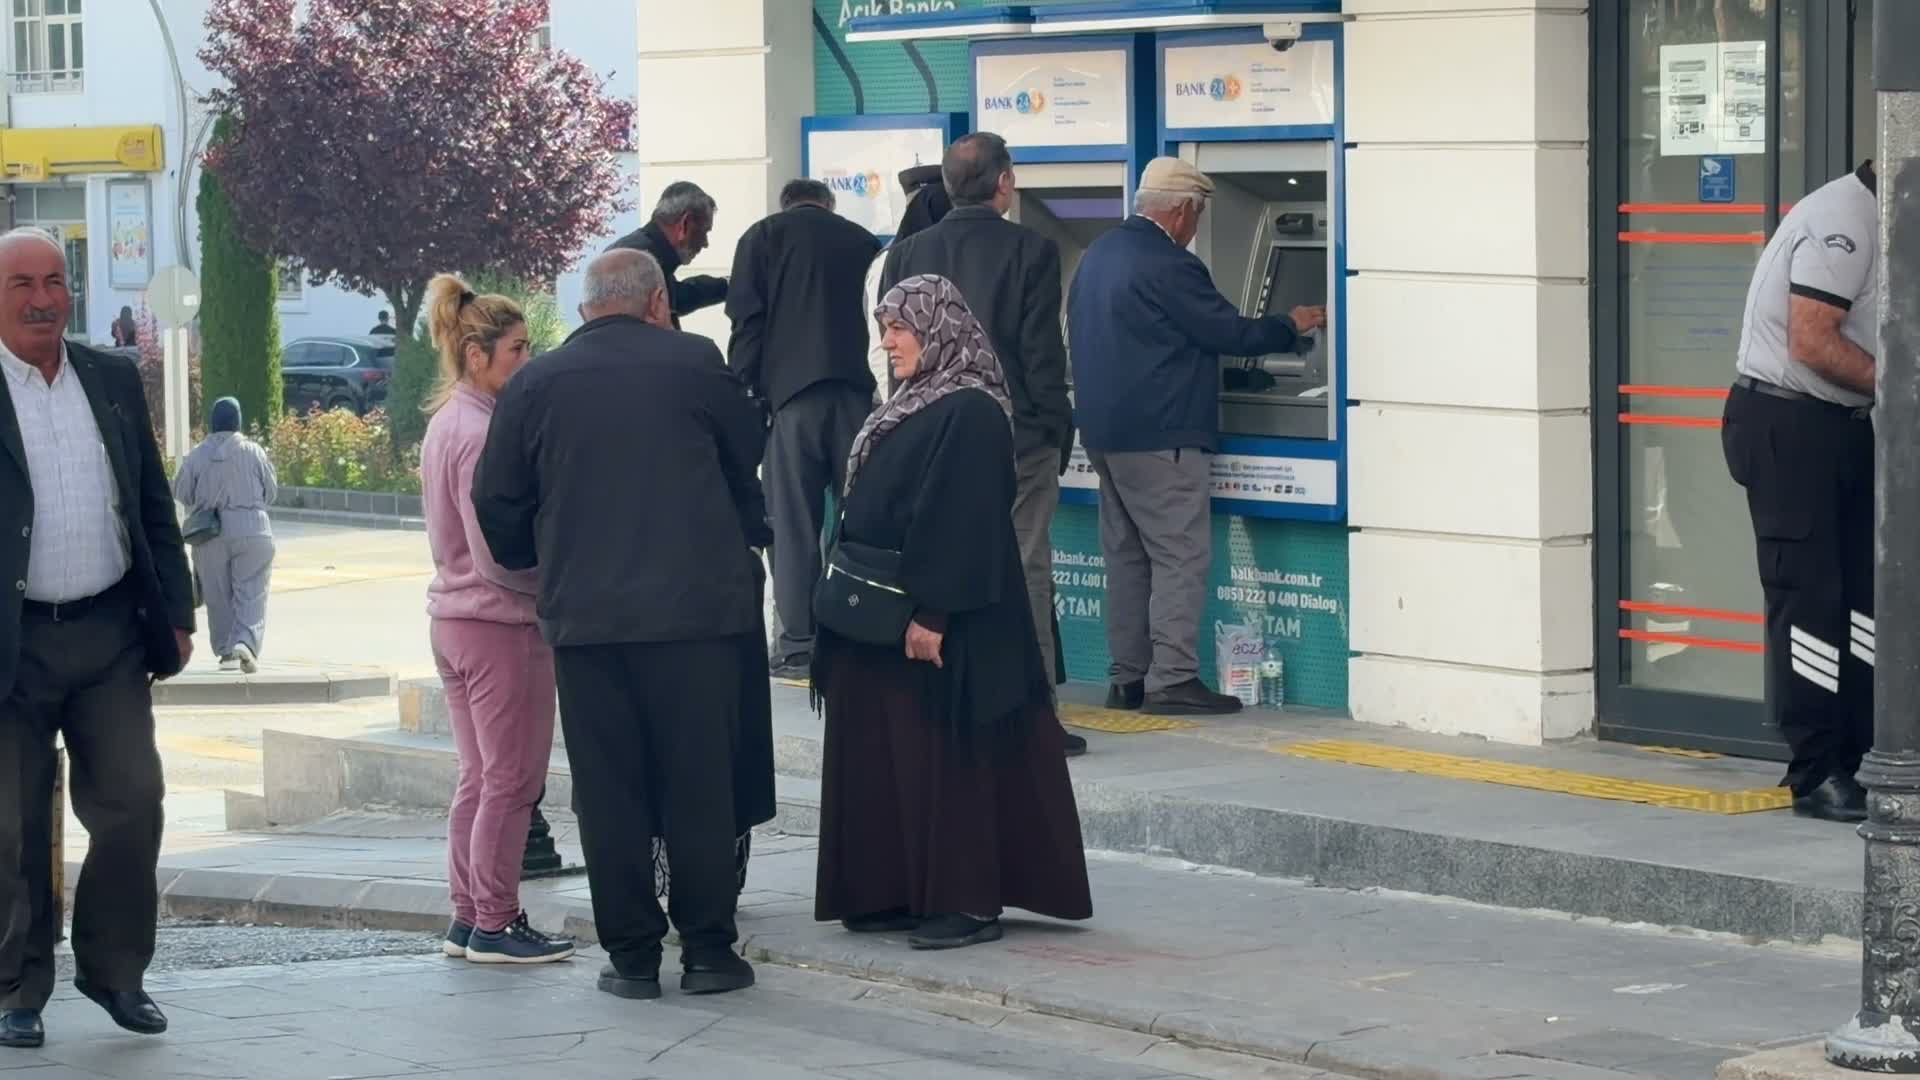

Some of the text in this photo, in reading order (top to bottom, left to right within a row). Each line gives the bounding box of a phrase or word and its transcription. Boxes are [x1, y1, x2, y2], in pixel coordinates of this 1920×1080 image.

[1176, 82, 1206, 96] BANK
[984, 97, 1012, 111] BANK
[1231, 565, 1323, 588] halkbank.com.tr
[1066, 596, 1100, 617] TAM
[1245, 587, 1267, 604] 222
[1268, 590, 1276, 605] 0
[1277, 591, 1299, 607] 400
[1300, 593, 1338, 614] Dialog
[1263, 615, 1301, 639] TAM
